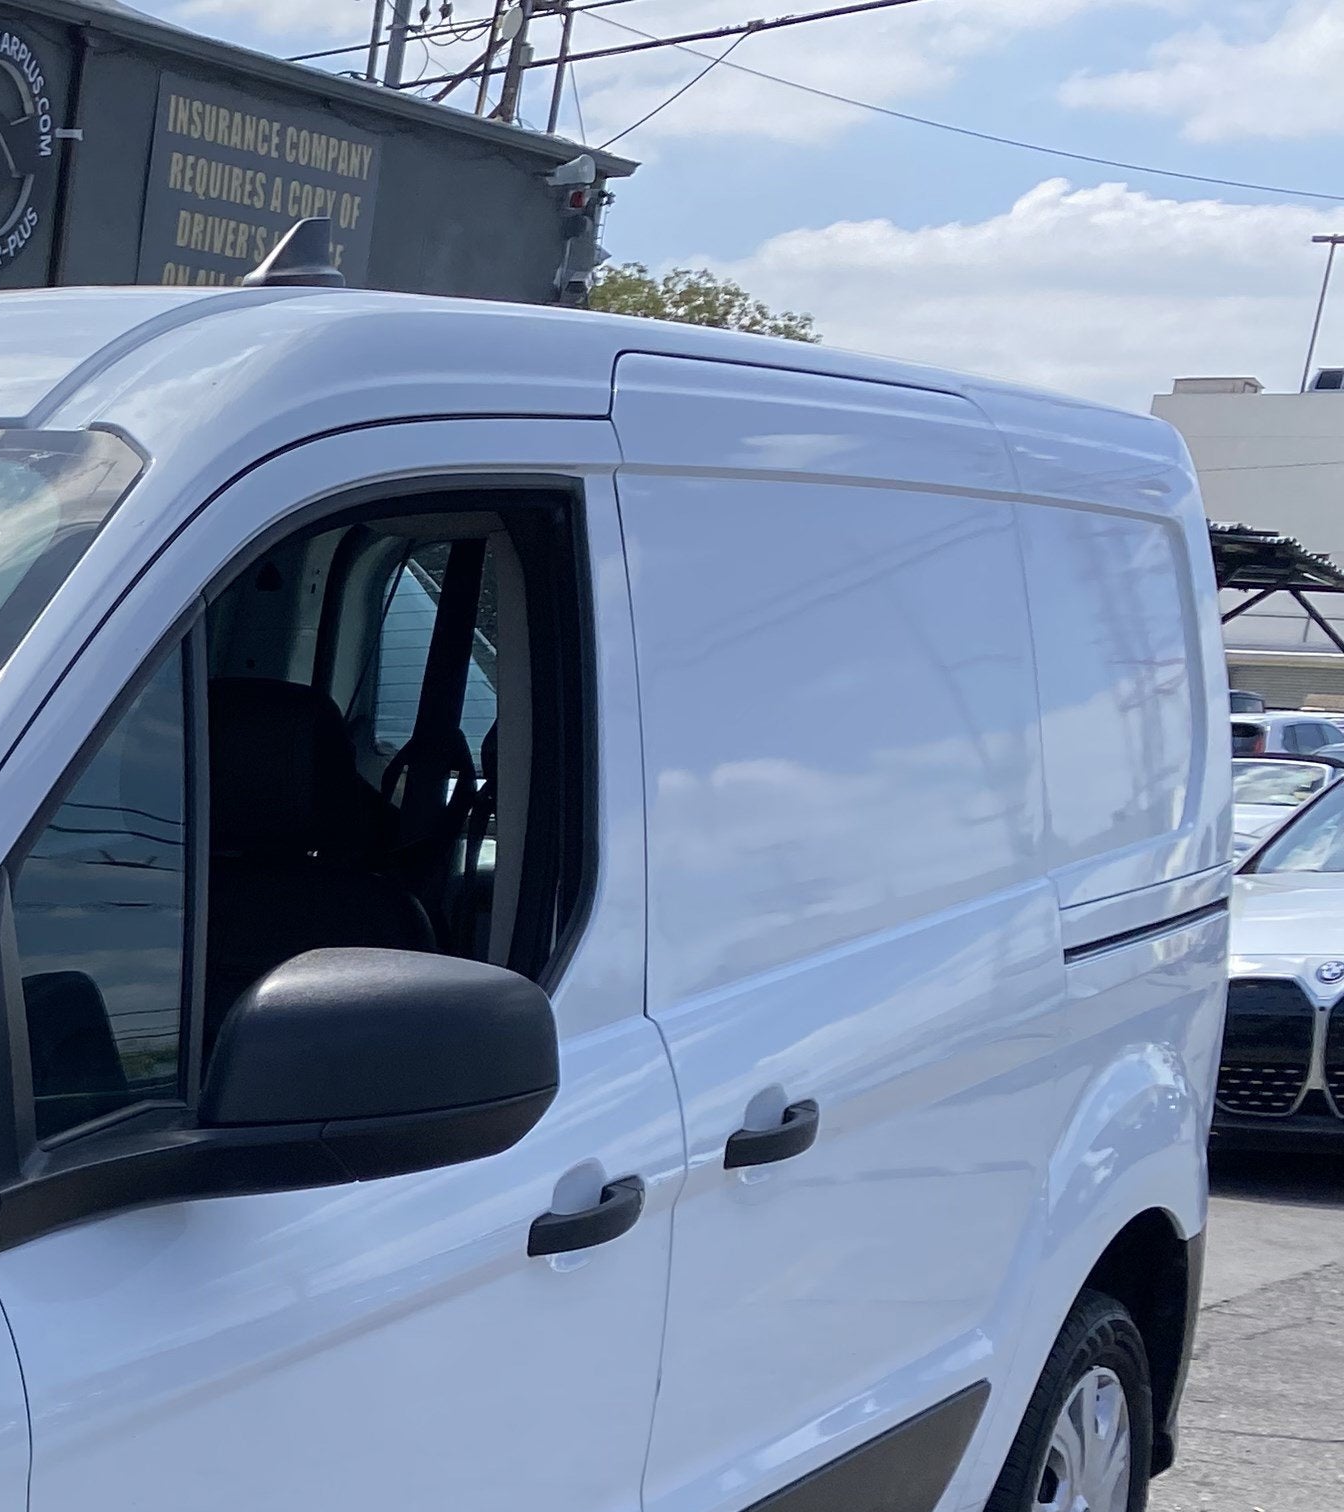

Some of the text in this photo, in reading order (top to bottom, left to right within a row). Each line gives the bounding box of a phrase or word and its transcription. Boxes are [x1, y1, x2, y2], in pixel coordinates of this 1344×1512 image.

[167, 94, 373, 181] INSURANCE COMPANY
[168, 152, 362, 230] REQUIRES A COPY OF
[175, 209, 268, 263] DRIVER'S
